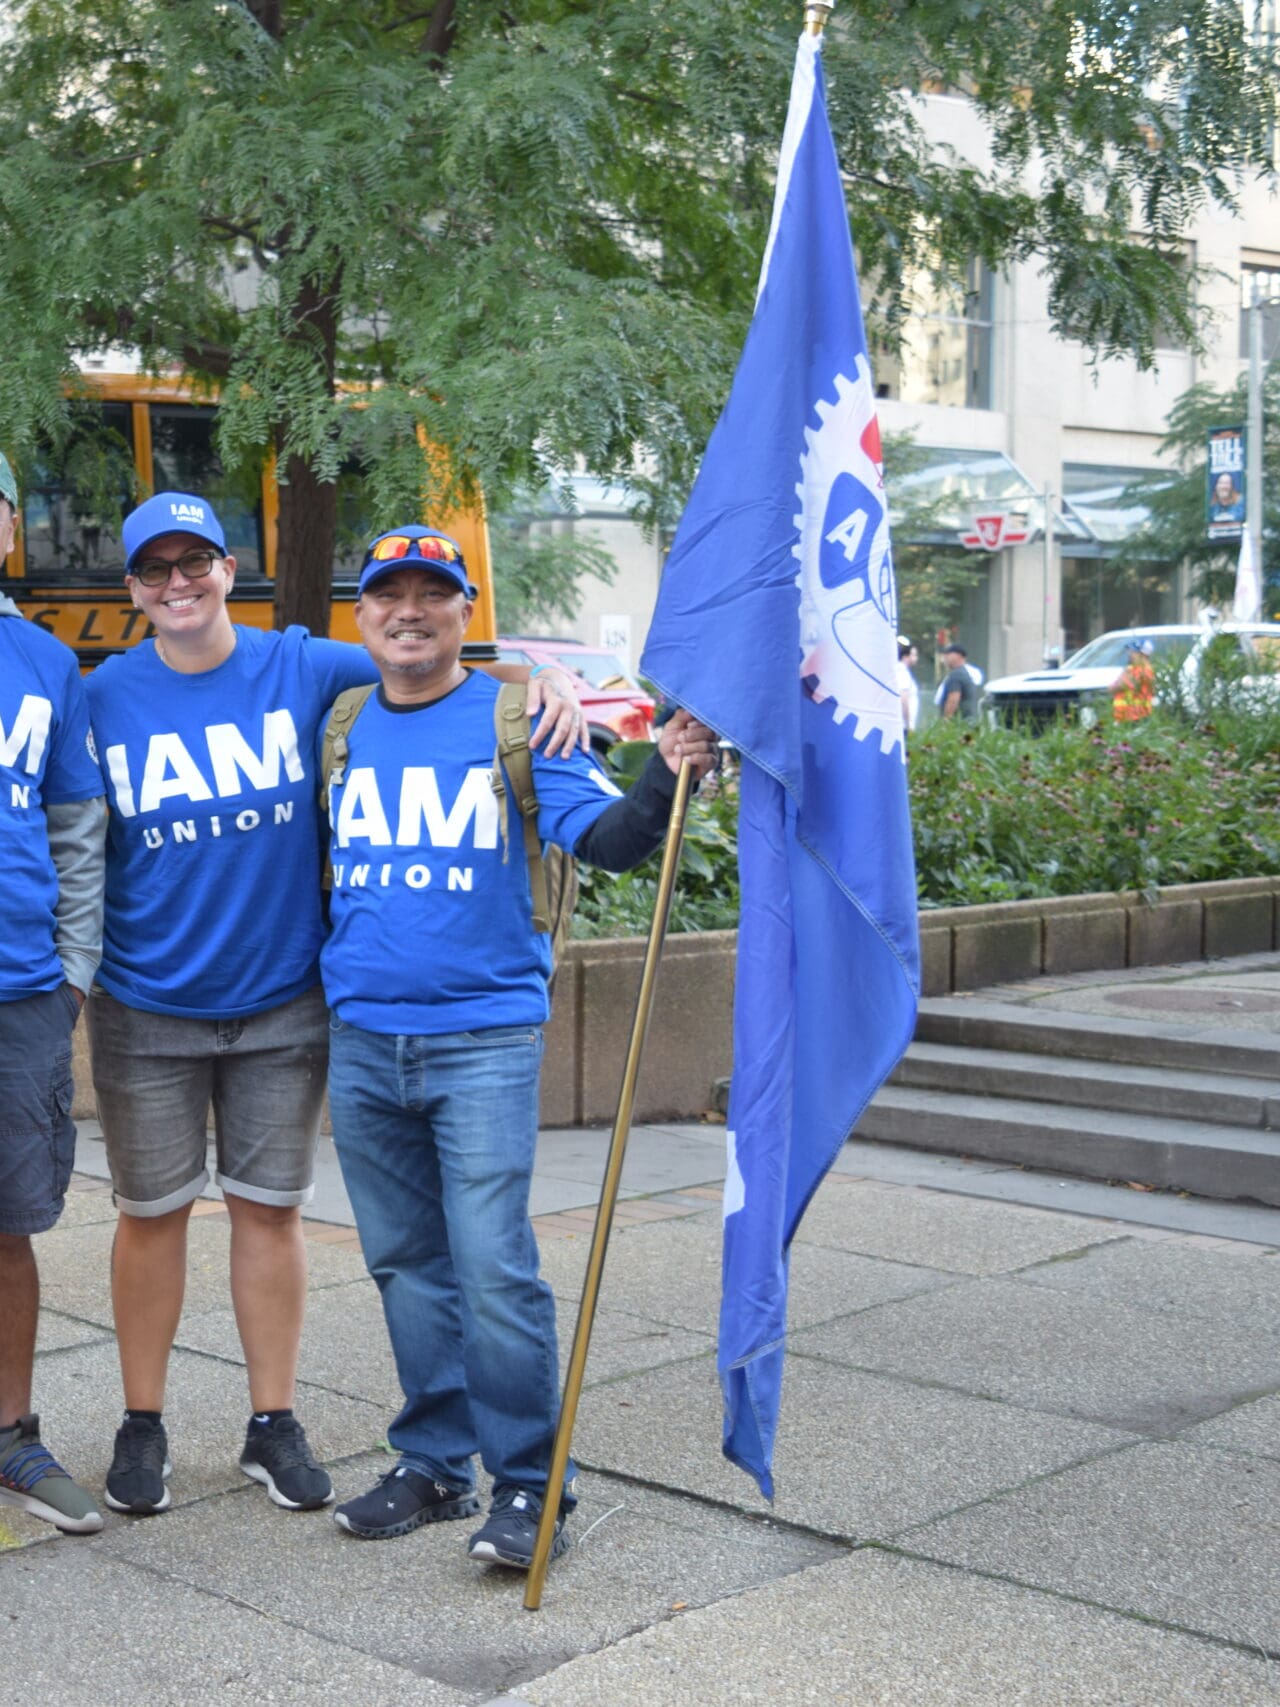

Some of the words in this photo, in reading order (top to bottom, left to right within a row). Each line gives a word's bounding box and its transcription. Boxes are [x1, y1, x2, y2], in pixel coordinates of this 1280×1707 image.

[170, 503, 204, 519] IAM
[106, 708, 305, 818] IAM
[143, 801, 294, 849] UNION
[328, 767, 499, 849] AM
[333, 863, 473, 891] UNION
